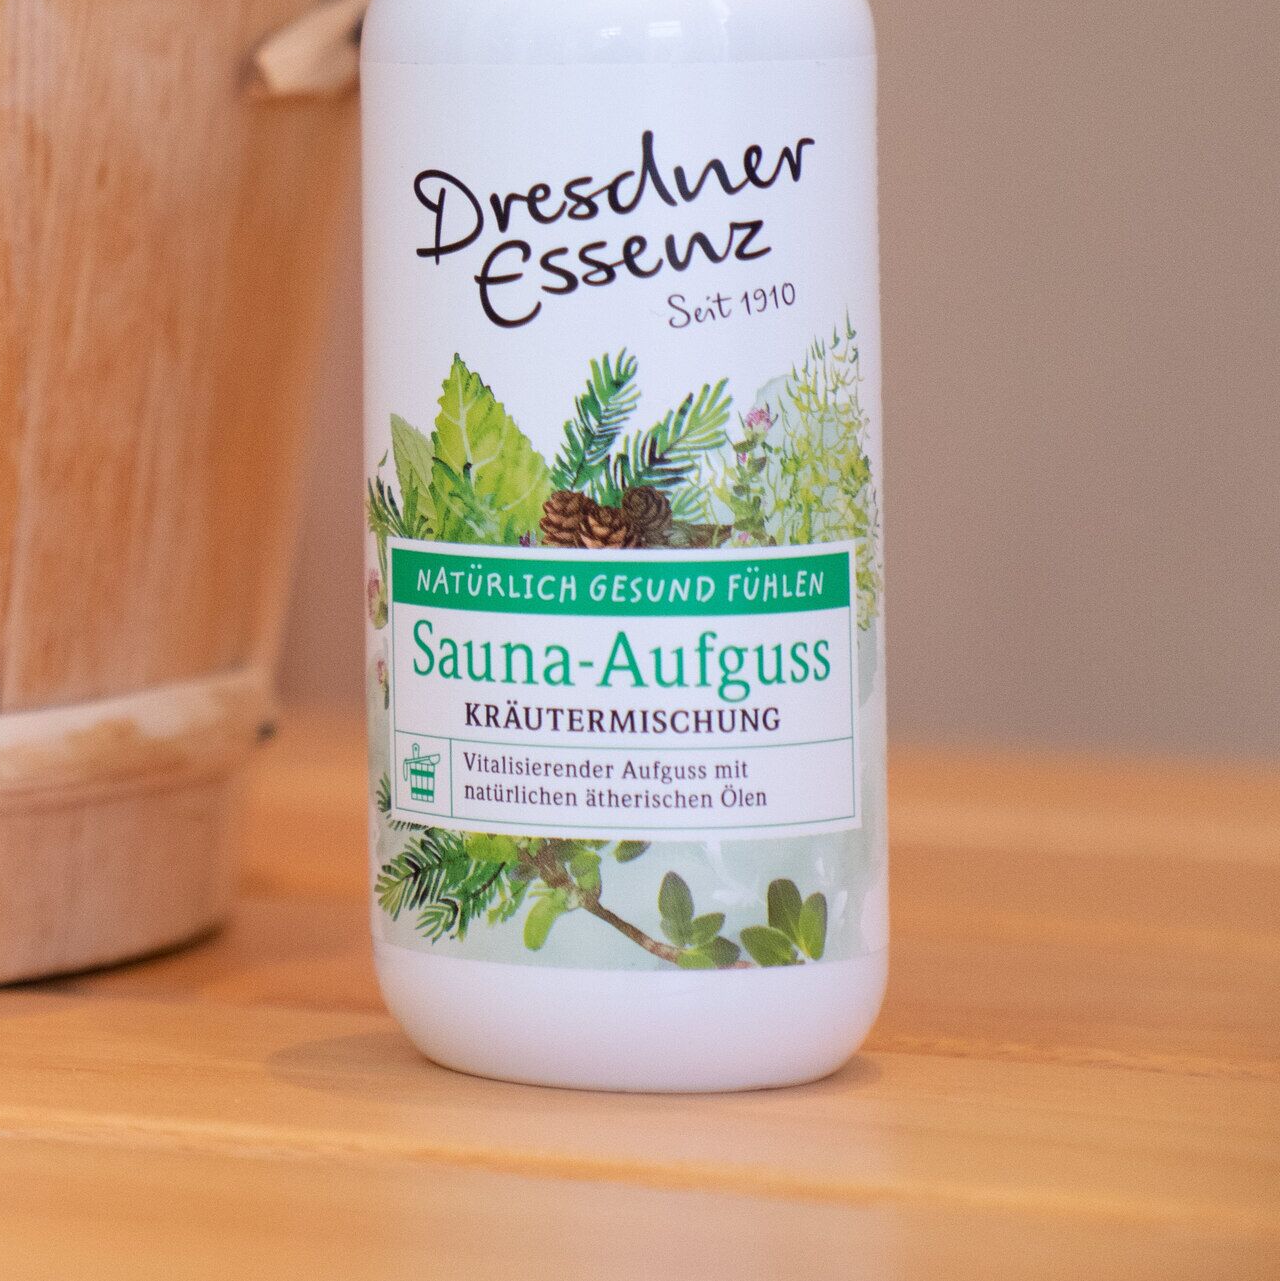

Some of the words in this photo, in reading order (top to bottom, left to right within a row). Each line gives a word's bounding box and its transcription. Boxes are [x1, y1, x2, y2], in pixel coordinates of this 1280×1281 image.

[413, 130, 815, 265] Dresdner
[473, 219, 772, 328] Essenz
[667, 293, 732, 329] Seit
[740, 281, 796, 316] 1910
[416, 564, 578, 602] NATÜRLICH
[589, 573, 716, 603] GESUND
[728, 567, 825, 602] FÜHLEN
[412, 620, 831, 703] Sauna-Aufguss
[464, 700, 781, 734] KRÄUTERMISCHUNG
[463, 752, 614, 780] Vitalisierender
[622, 760, 707, 784] Aufguss
[714, 761, 749, 780] mit
[464, 784, 578, 807] natürlichen
[585, 787, 714, 809] ätherischen
[720, 786, 768, 808] Ölen
